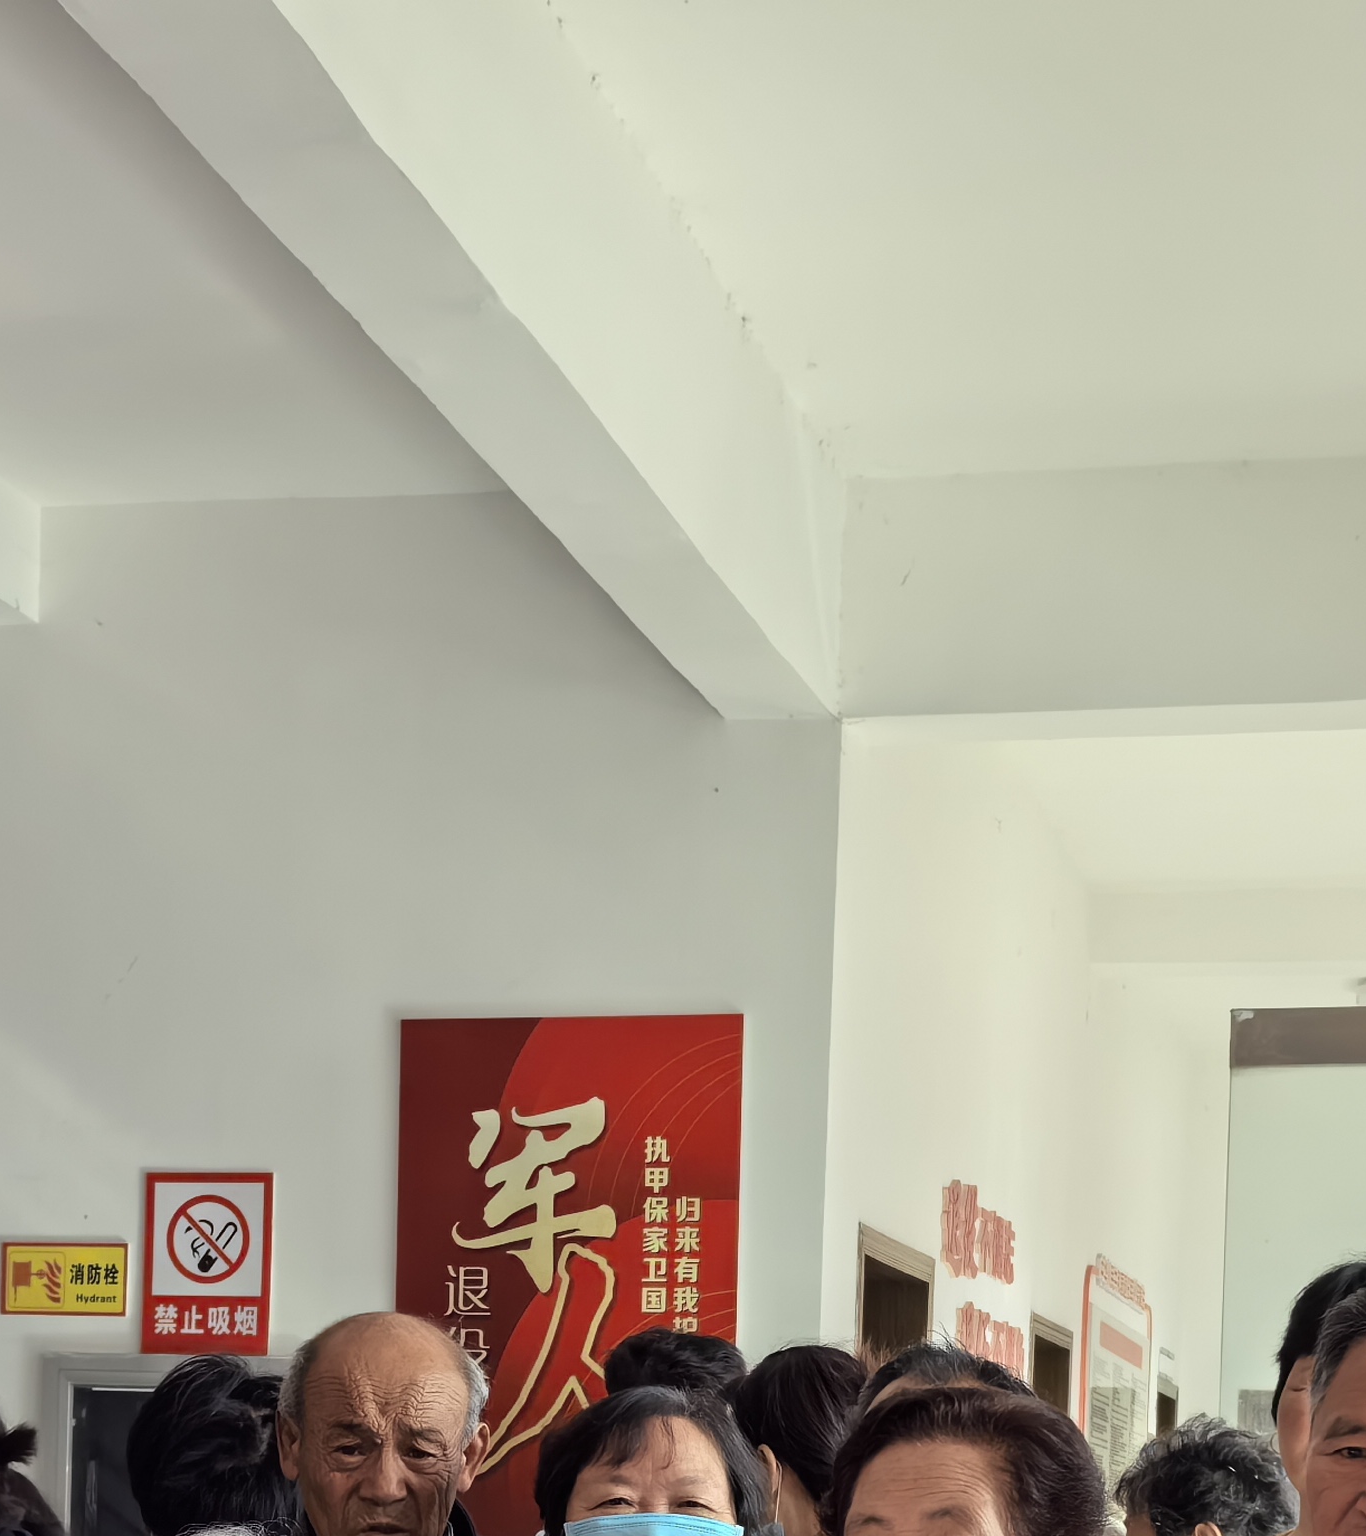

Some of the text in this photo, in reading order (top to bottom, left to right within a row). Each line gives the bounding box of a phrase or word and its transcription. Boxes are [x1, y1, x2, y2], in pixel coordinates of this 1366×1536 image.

[641, 1136, 670, 1314] 执甲保家卫国
[69, 1263, 120, 1286] 消防栓
[76, 1293, 117, 1304] Hydrant
[154, 1304, 258, 1336] 禁止吸烟
